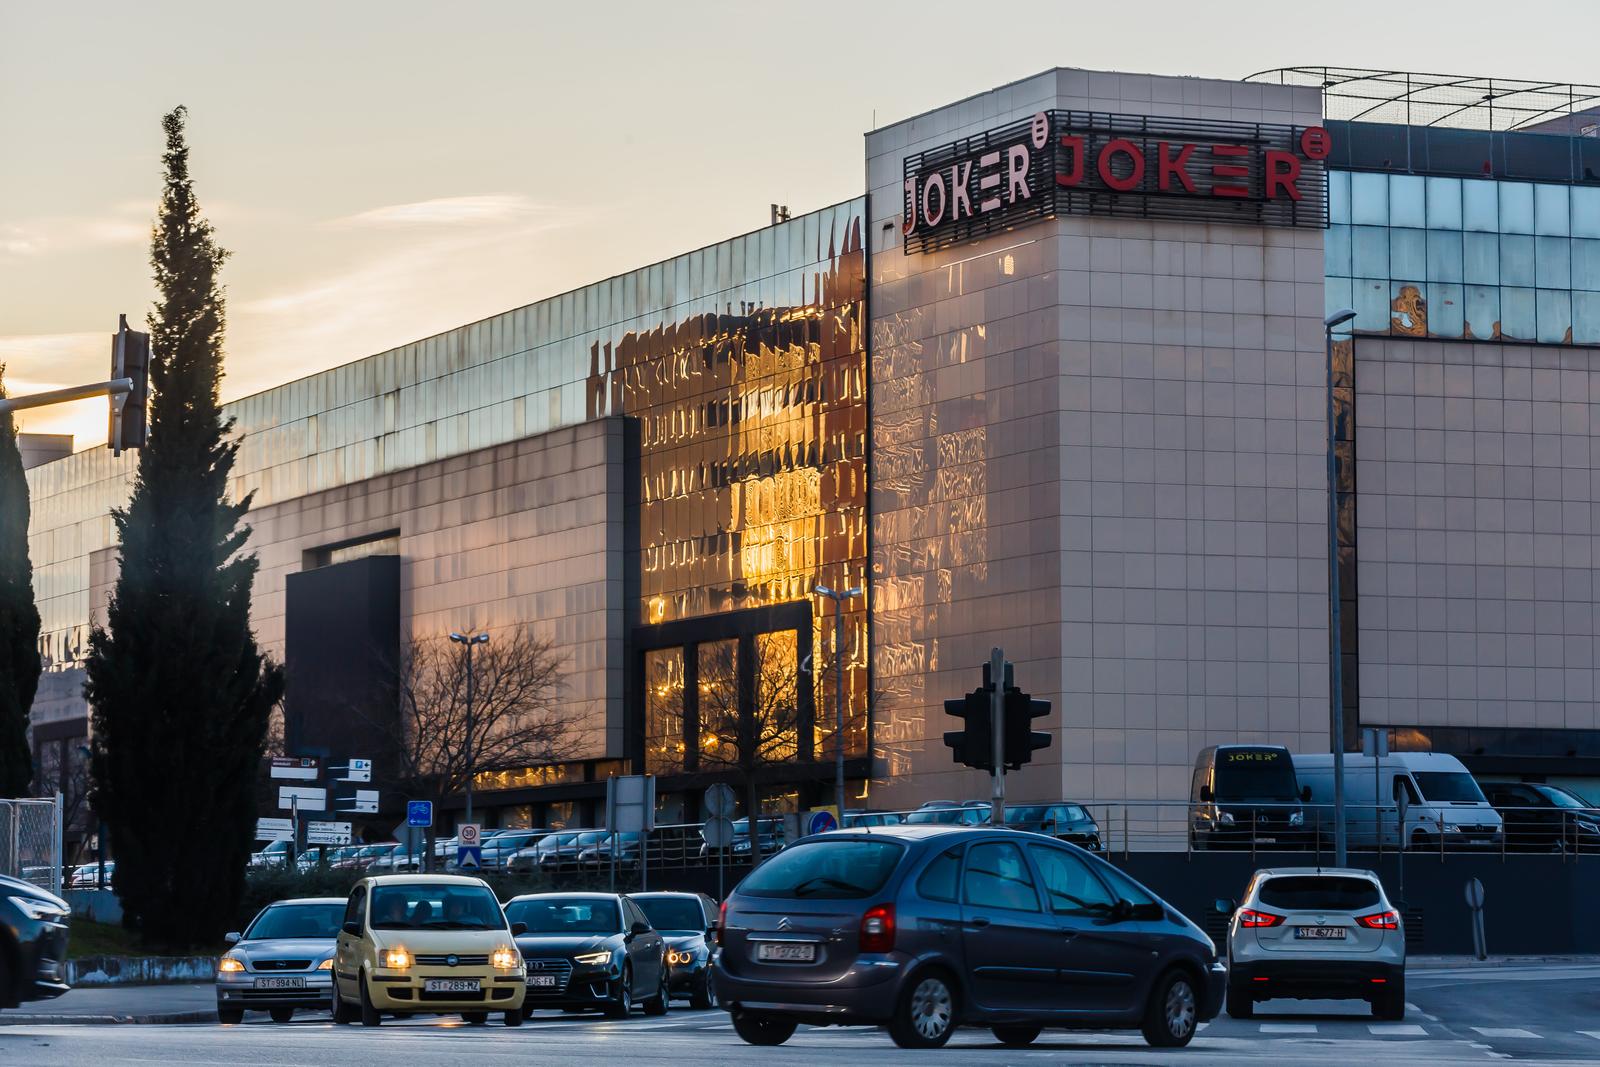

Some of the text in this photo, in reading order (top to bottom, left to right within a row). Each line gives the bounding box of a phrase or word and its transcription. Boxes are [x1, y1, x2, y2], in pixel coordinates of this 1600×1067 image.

[1055, 136, 1303, 201] JOKER
[902, 144, 1031, 236] JOKER
[1229, 753, 1272, 762] JOKER
[465, 829, 474, 837] 30
[1300, 928, 1310, 937] ST
